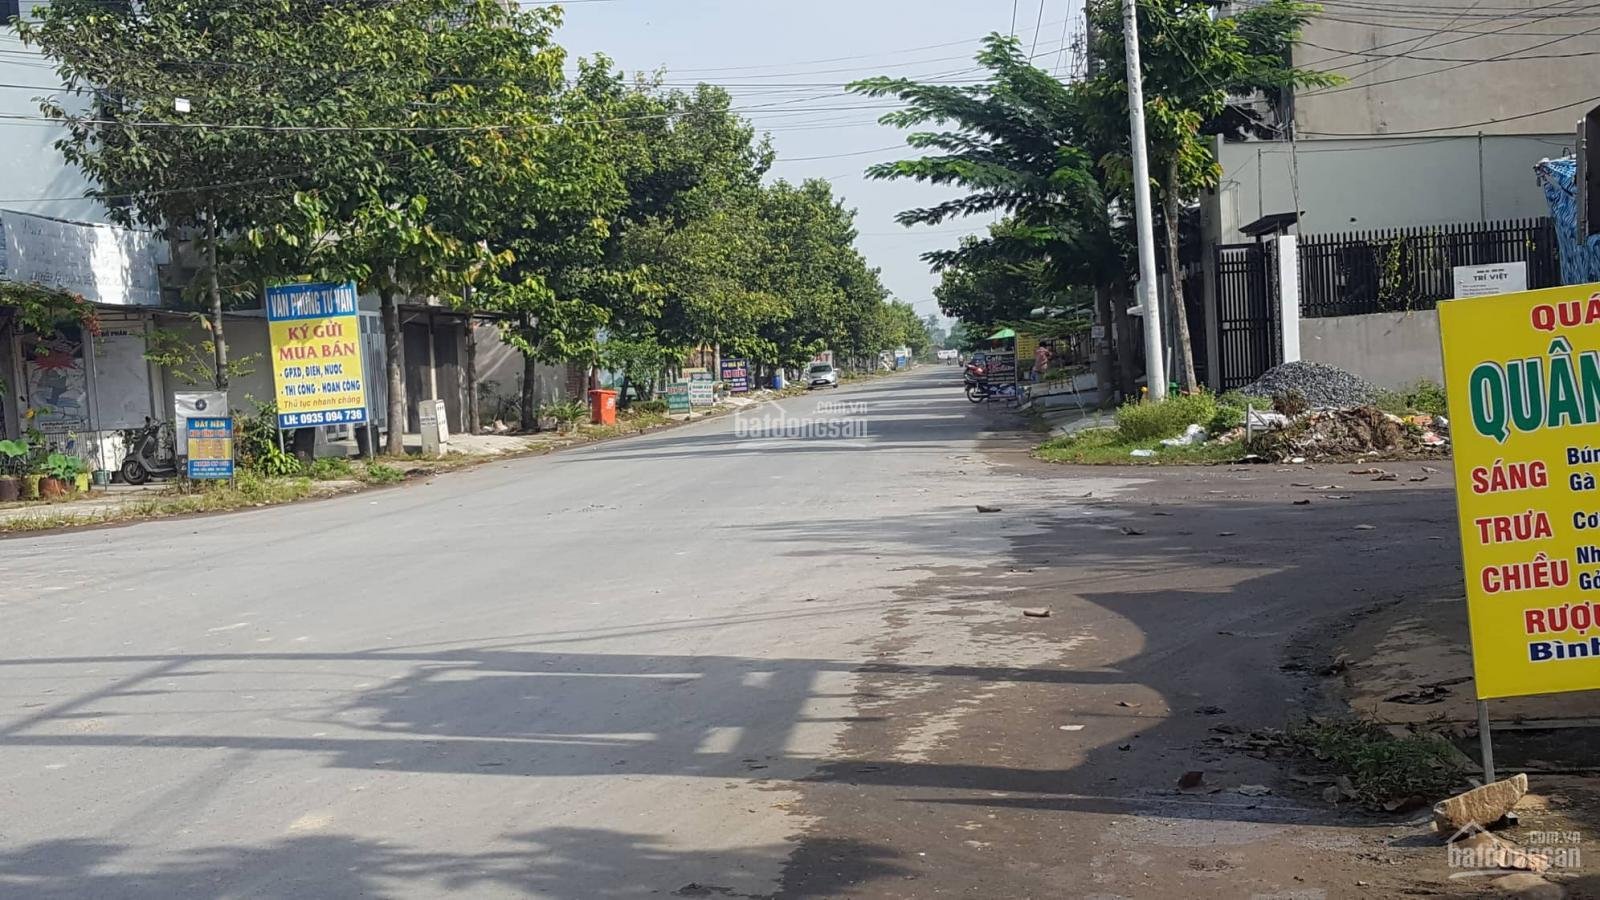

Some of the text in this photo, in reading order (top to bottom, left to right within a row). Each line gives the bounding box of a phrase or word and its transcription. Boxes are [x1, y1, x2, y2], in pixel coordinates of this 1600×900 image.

[288, 319, 343, 340] KÝ GỬI
[280, 341, 355, 360] MUA BÁN
[313, 397, 336, 407] nhanh
[300, 412, 324, 424] 0935
[325, 411, 343, 423] 094
[1471, 459, 1548, 494] SÁNG
[1569, 472, 1596, 491] Gà
[1475, 510, 1553, 544] TRƯA
[1481, 553, 1569, 593] CHIỀU
